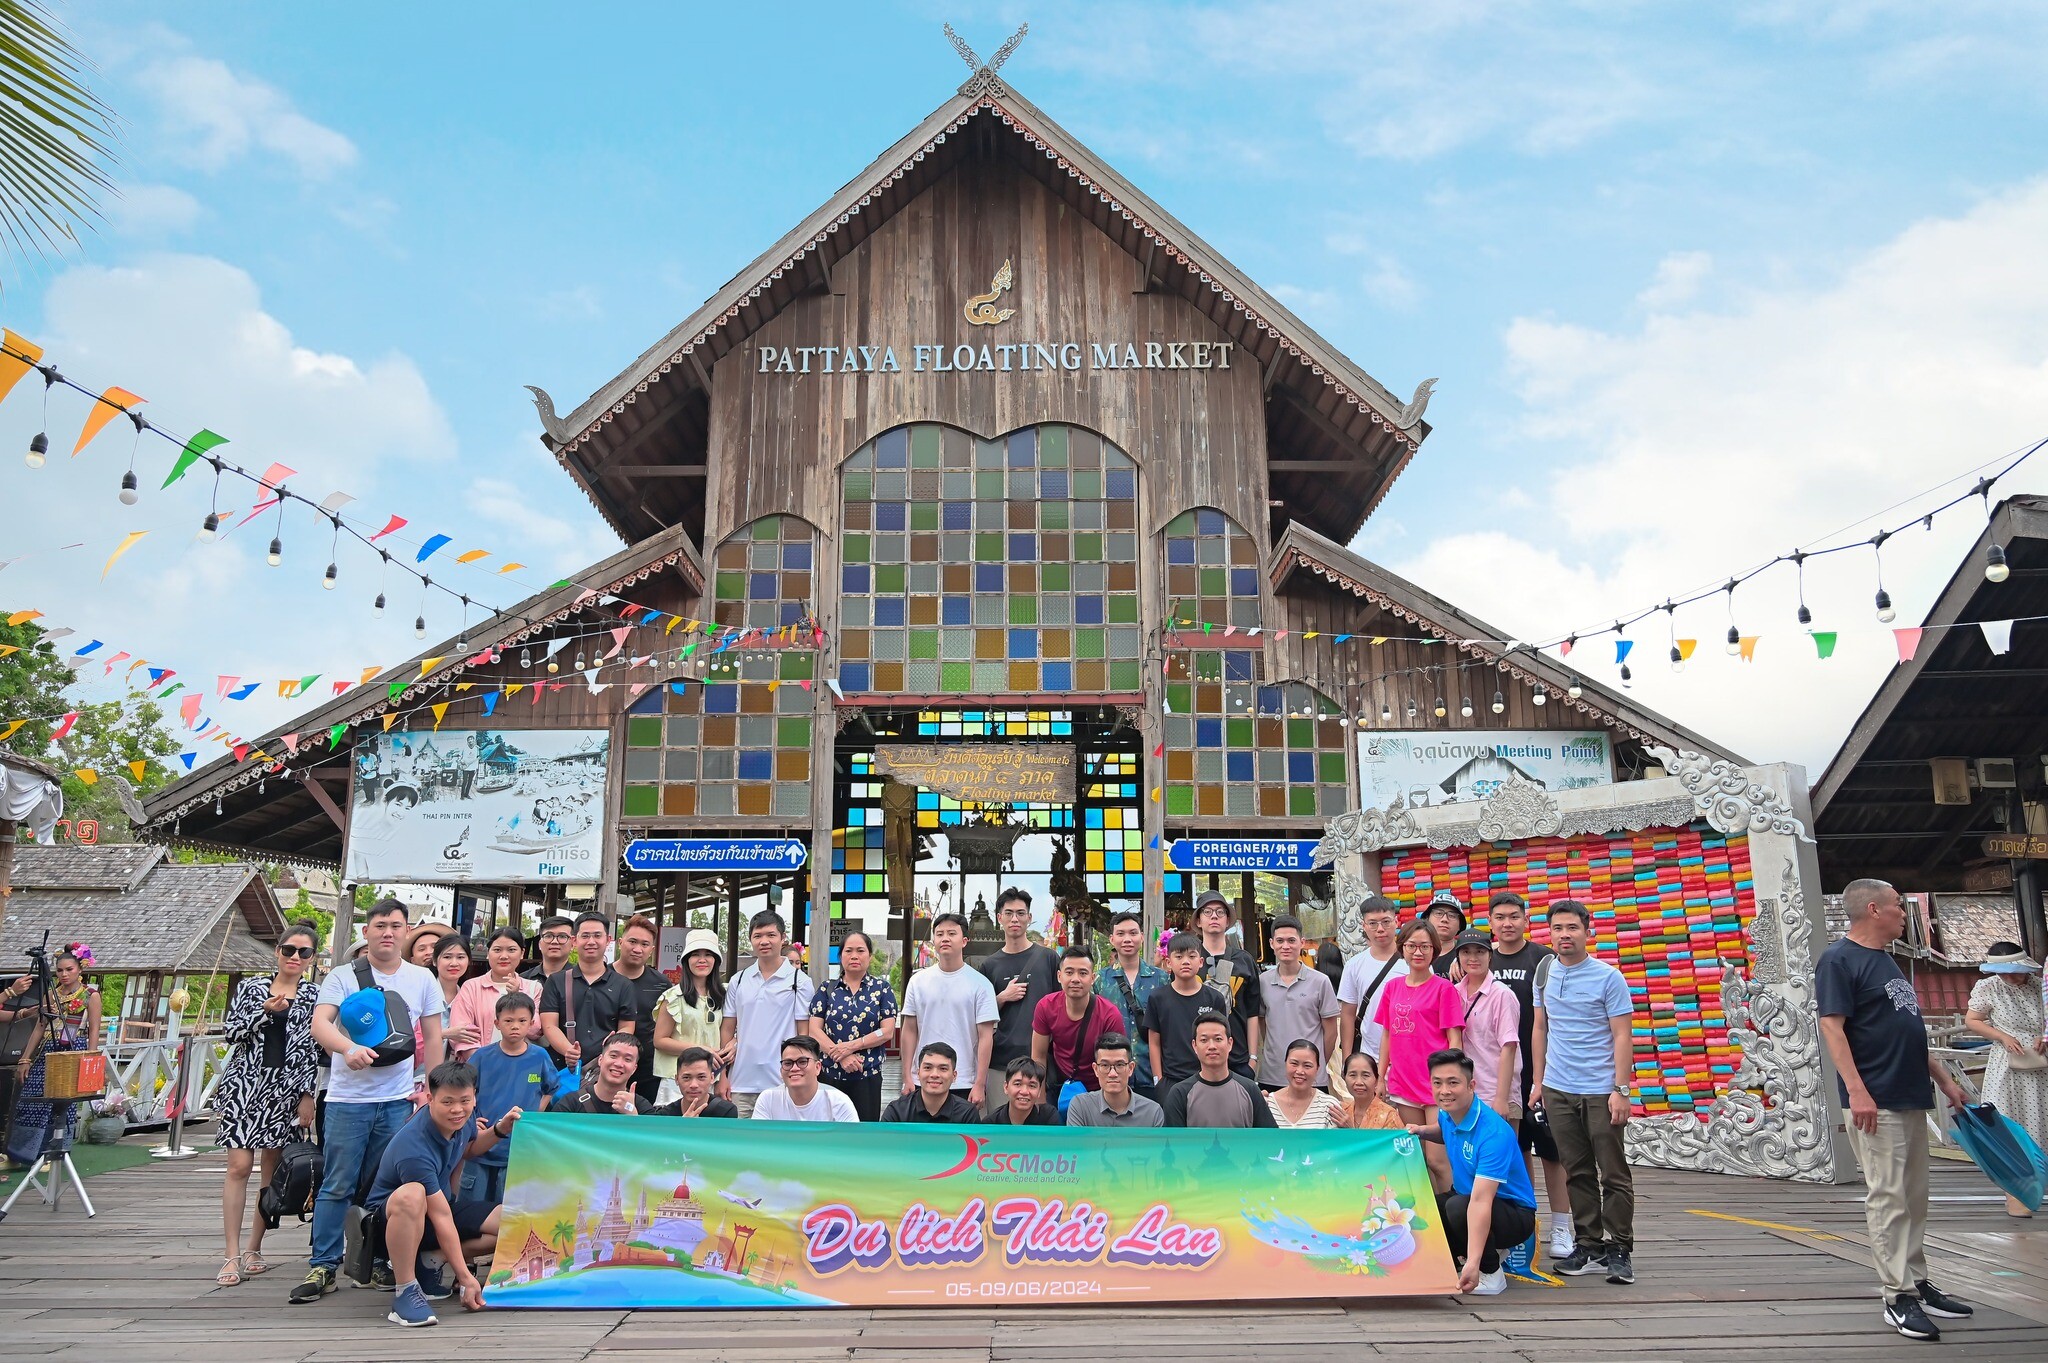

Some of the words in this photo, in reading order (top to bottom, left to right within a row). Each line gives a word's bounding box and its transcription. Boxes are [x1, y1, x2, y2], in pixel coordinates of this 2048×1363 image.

[758, 345, 900, 374] PATTAYA
[913, 343, 1082, 372] FLOATING
[1092, 341, 1235, 370] MARKET
[1496, 744, 1552, 760] Meeting
[1561, 744, 1599, 758] Point
[956, 786, 1011, 801] Floating
[1014, 787, 1058, 801] market
[546, 844, 590, 860] ท่าเรือ
[538, 862, 565, 875] Pier
[1193, 856, 1270, 867] ENTRANCE/
[1493, 968, 1527, 981] ANOI
[976, 1174, 1011, 1183] Creative,
[1013, 1174, 1038, 1183] Speed
[1040, 1175, 1055, 1183] and
[1057, 1175, 1080, 1185] Crazy
[803, 1203, 889, 1268] Du
[899, 1198, 985, 1262] lịch
[993, 1197, 1105, 1260] Thái
[1109, 1205, 1221, 1264] Lan
[945, 1281, 1102, 1297] 05-09/06/2024
